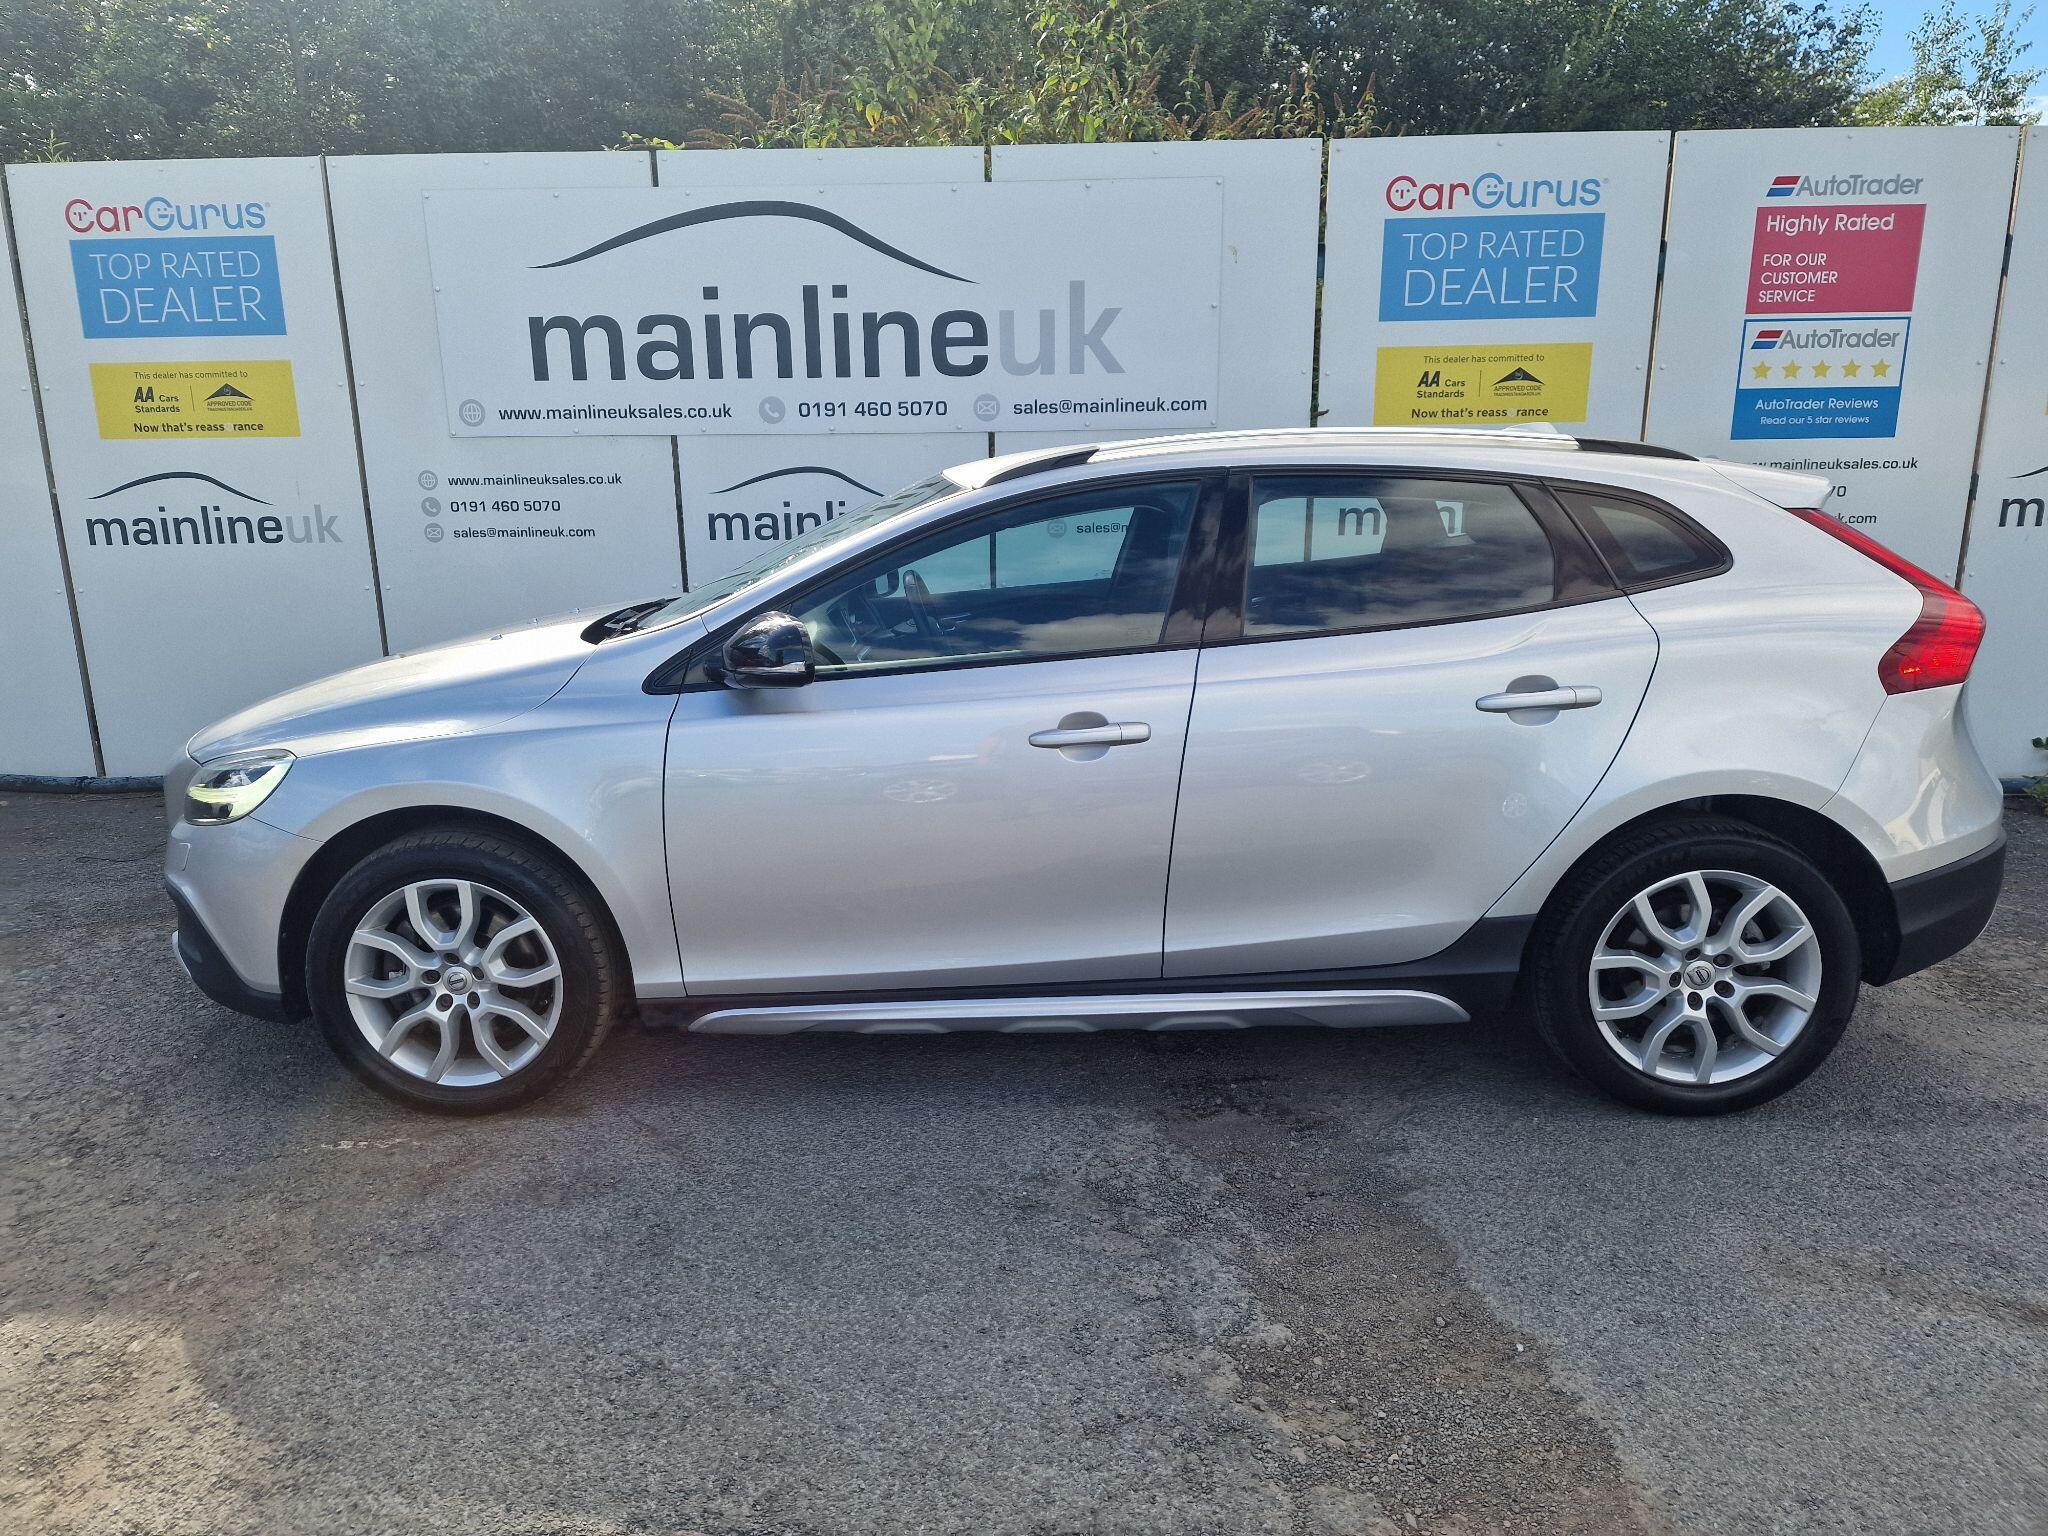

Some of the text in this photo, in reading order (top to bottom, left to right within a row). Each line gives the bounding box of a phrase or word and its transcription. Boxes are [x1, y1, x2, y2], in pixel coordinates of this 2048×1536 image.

[1386, 173, 1600, 211] CarGurus
[1796, 174, 1924, 197] AutoTrader
[65, 197, 265, 233] CarGurus
[1767, 213, 1894, 236] Highly Rated
[1403, 230, 1584, 260] TOP RATED
[89, 251, 260, 279] TOP RATED
[1763, 253, 1826, 266] FOR OUR
[1761, 271, 1837, 285] CUSTOMER
[1405, 265, 1577, 306] DEALER
[1759, 289, 1815, 302] SERVICE
[100, 285, 266, 323] DEALER
[1778, 328, 1901, 350] AutoTrader
[1424, 353, 1544, 364] This dealer has committed to
[134, 370, 247, 380] This dealer has committed to
[1417, 371, 1465, 388] AA Cars
[134, 387, 179, 403] AA Cars
[1417, 389, 1464, 399] Standards
[135, 404, 180, 414] Standards
[799, 401, 947, 417] 0191 460 5070
[1014, 397, 1206, 414] sales@mainlineuk.com
[1755, 398, 1878, 410] AutoTrader Reviews
[499, 404, 732, 419] www.mainlineuksales.co.uk
[1412, 407, 1549, 419] Now that's reassrance
[1761, 414, 1869, 425] Read our 5 star reviews
[134, 422, 263, 433] Now that's reassrance
[448, 473, 622, 485] www.mainlineuksales.co.uk
[451, 501, 560, 512] 0191 460 5070
[454, 526, 595, 538] sales@mainlineuk.com
